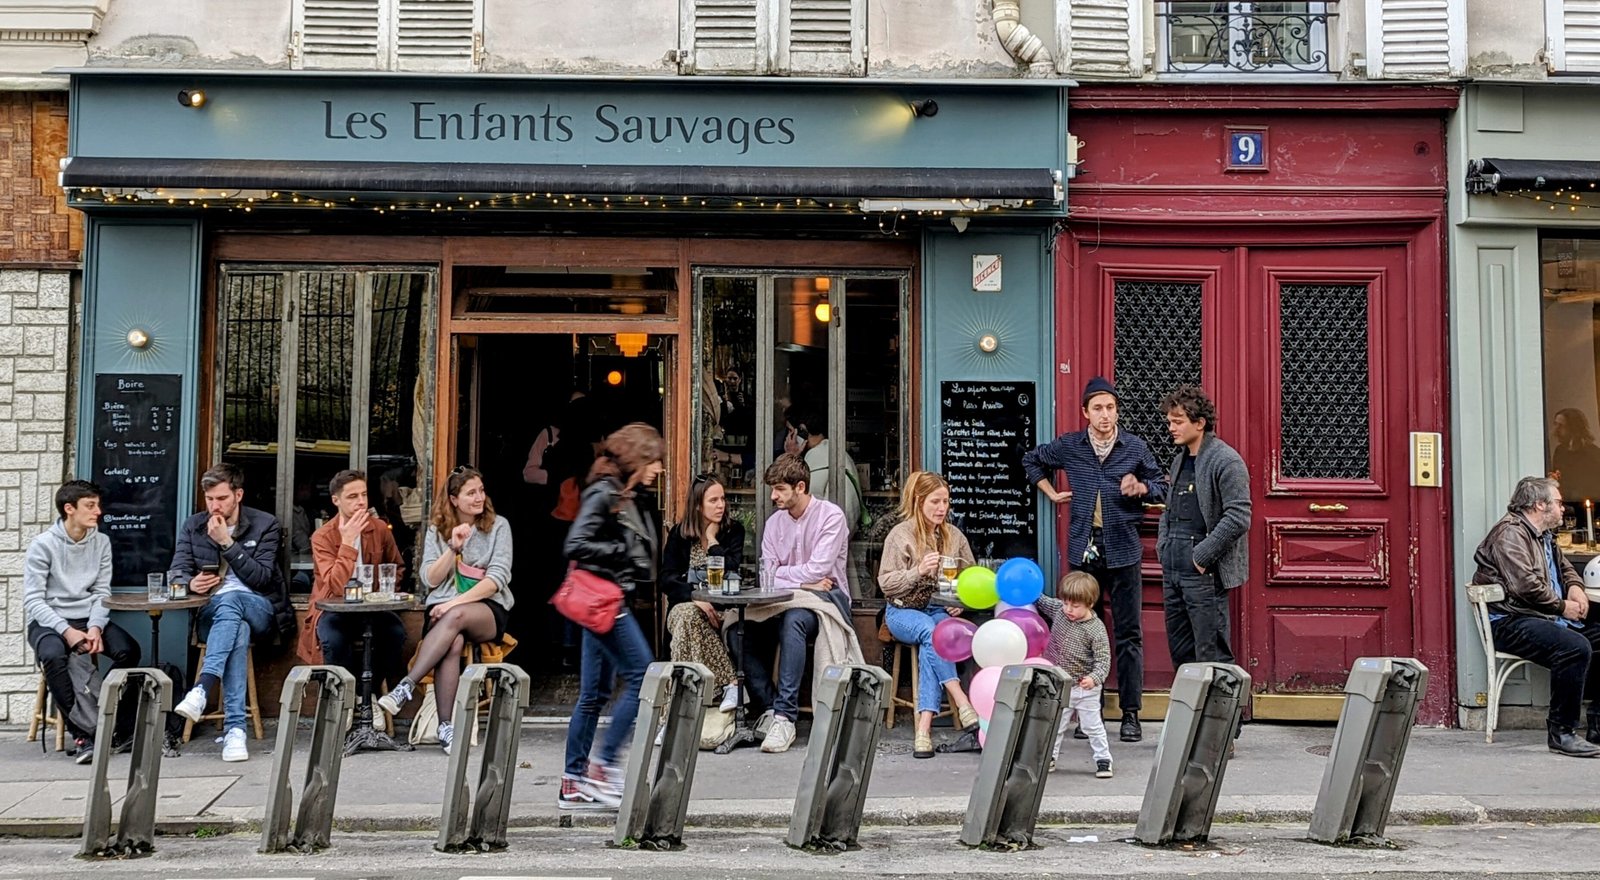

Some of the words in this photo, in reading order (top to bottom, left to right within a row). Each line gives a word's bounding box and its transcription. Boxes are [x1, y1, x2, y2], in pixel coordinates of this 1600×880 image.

[321, 100, 387, 140] Les
[410, 102, 574, 142] Enfants
[595, 104, 795, 155] Sauvages
[1238, 136, 1255, 162] 9
[117, 379, 144, 389] Boire
[1024, 416, 1030, 425] 3
[1024, 427, 1030, 437] 6
[104, 467, 130, 475] Cocktails
[1028, 513, 1035, 521] 10
